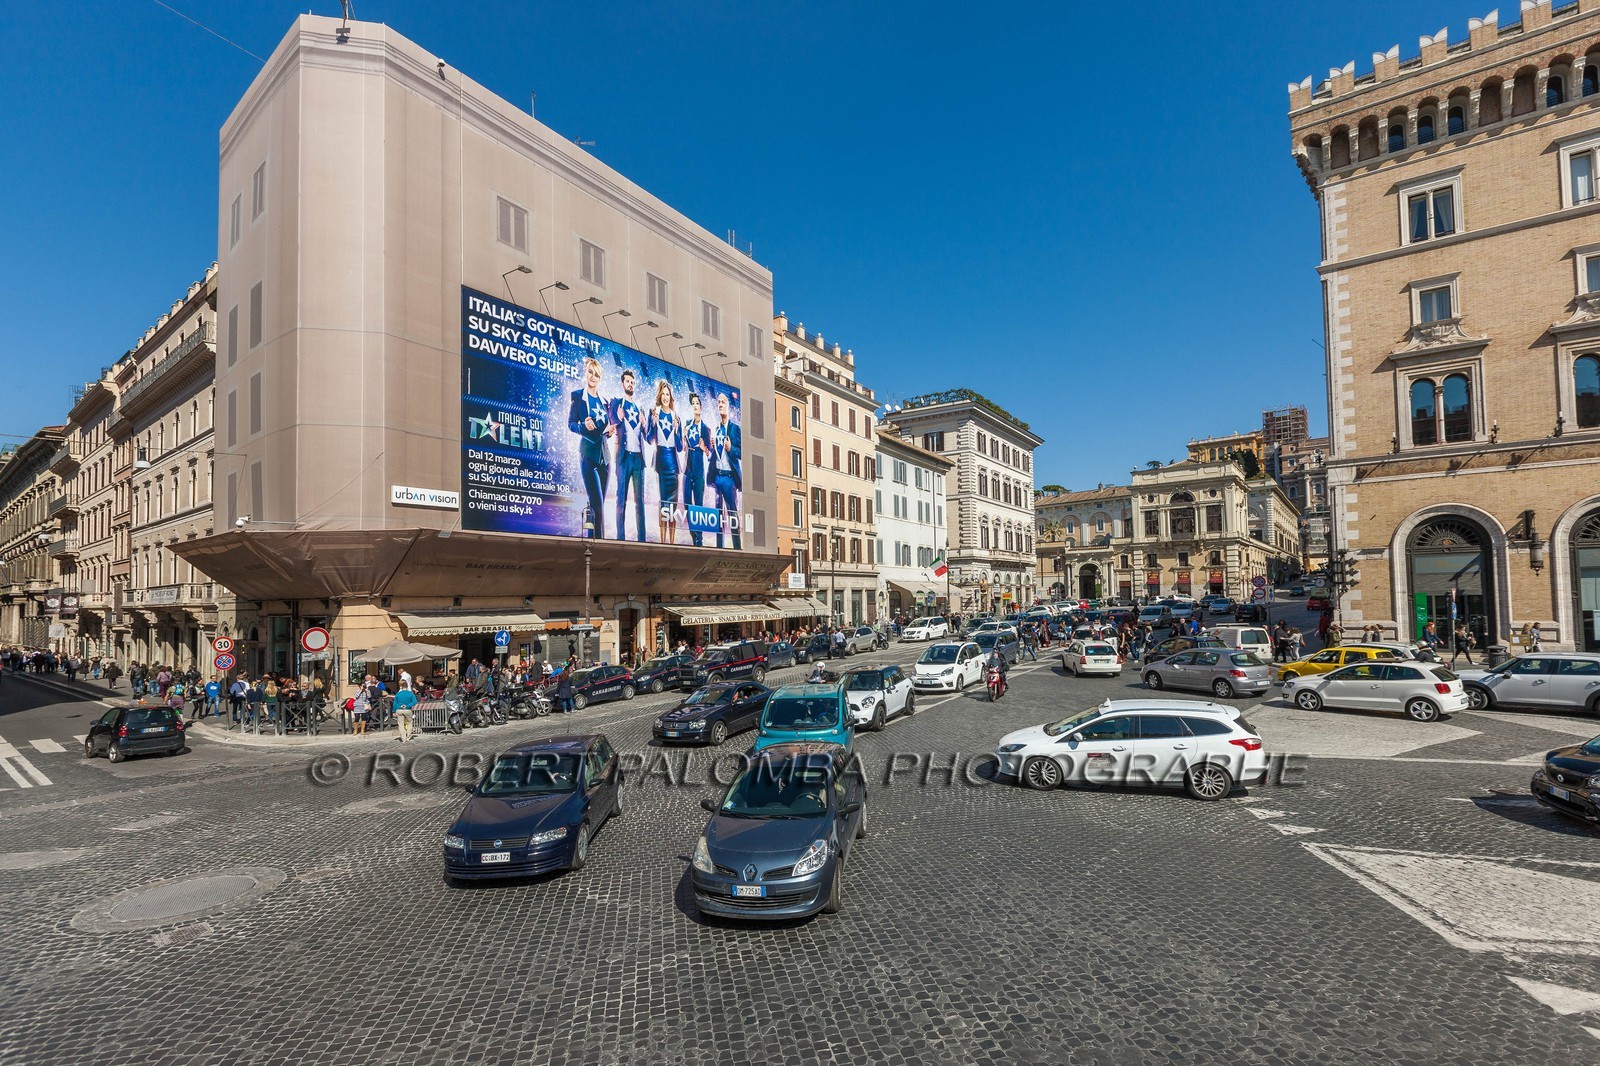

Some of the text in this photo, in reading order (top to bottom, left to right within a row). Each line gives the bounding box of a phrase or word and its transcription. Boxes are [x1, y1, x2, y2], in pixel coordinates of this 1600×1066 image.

[469, 296, 601, 354] ITALIA'S GOT TALENT
[469, 315, 558, 355] SU SKY SARÀ
[469, 334, 537, 366] DAVVERO
[498, 411, 543, 430] ITALIA'S GOT
[468, 449, 521, 466] Dal 12 marzo
[468, 462, 553, 481] ogni giovedì alle 21.10
[468, 473, 479, 481] su
[481, 473, 497, 485] Sky
[498, 476, 515, 486] Uno
[516, 479, 530, 489] HD,
[531, 482, 556, 492] canale
[468, 489, 543, 505] Chiamaci 02.7070
[476, 501, 497, 511] vieni
[509, 504, 533, 516] sky.it
[690, 510, 717, 528] UNO
[720, 514, 739, 529] HD
[682, 616, 715, 625] GELATERIA
[751, 613, 781, 621] RISTORANTE
[217, 640, 230, 649] 30
[730, 664, 753, 673] CARABINIERI
[591, 685, 622, 696] CARABINIERI
